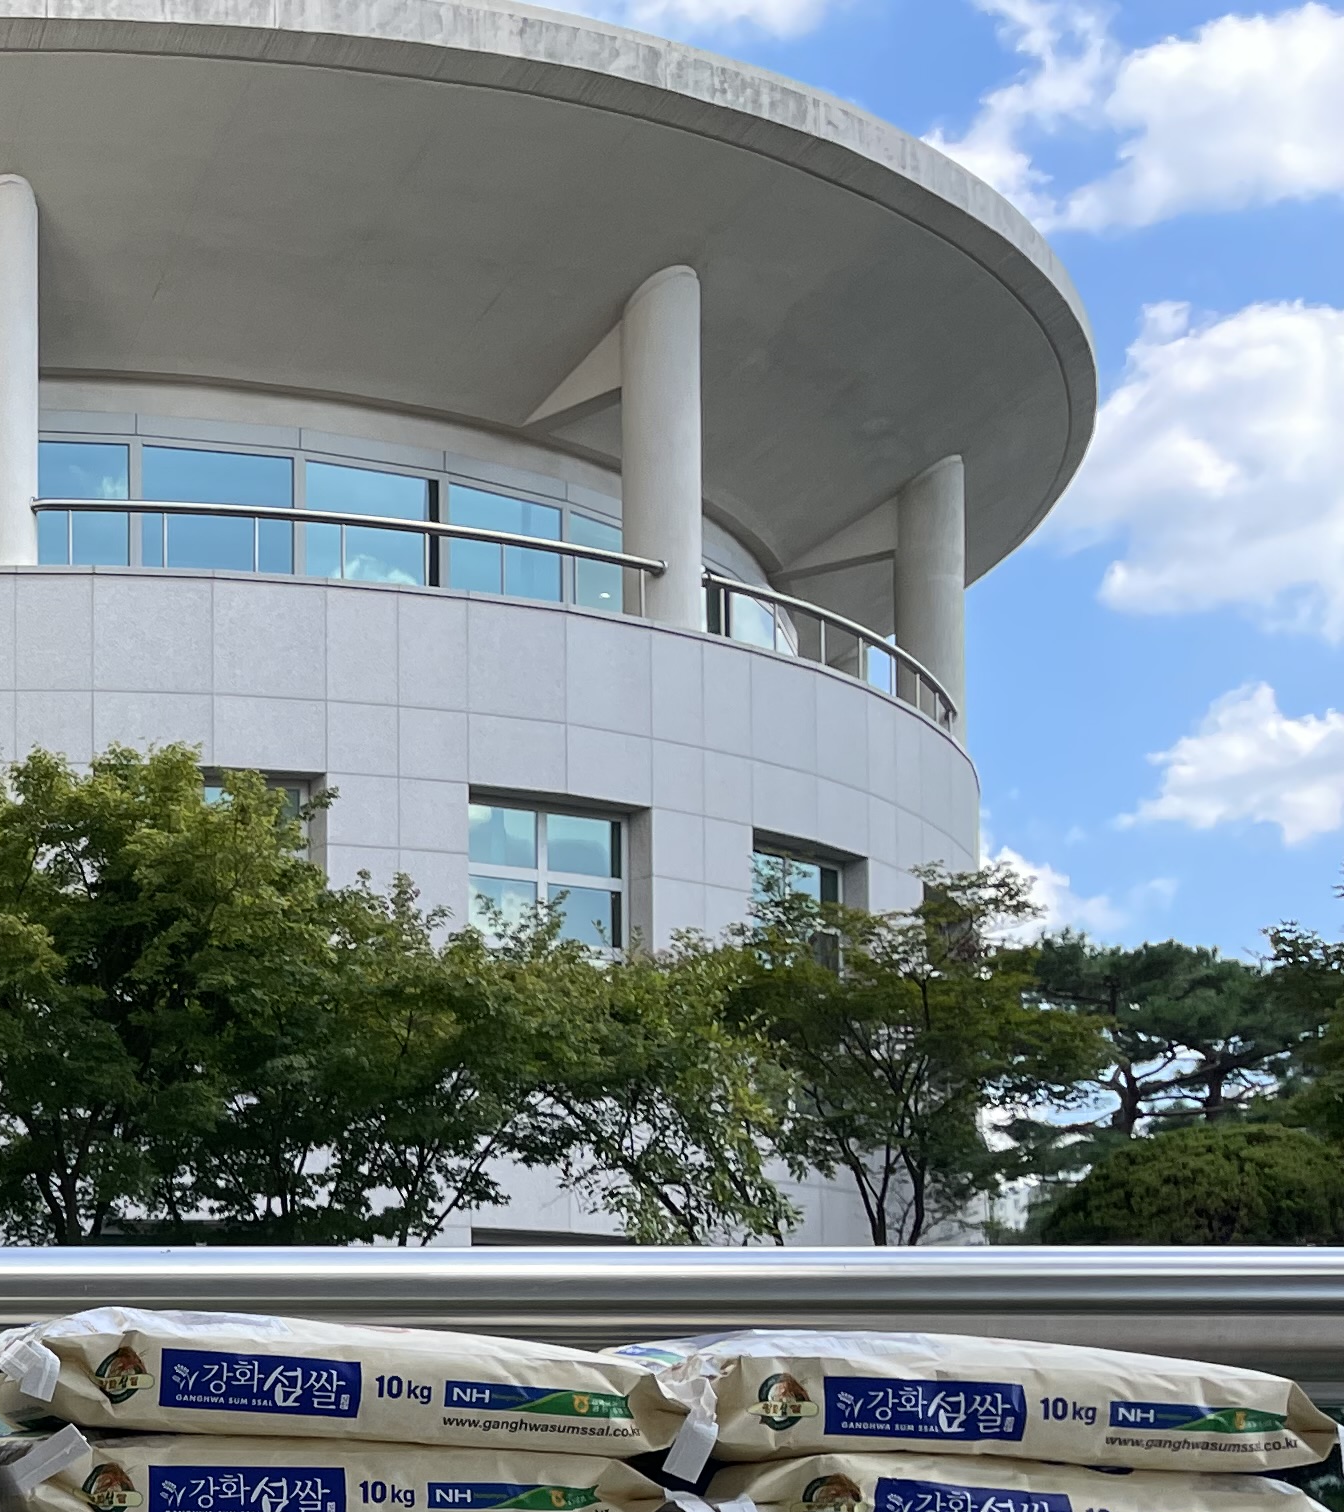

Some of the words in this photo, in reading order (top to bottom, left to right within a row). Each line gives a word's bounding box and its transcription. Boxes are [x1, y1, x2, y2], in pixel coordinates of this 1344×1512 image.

[175, 1394, 224, 1404] GANGHWA
[228, 1397, 248, 1405] SUM
[251, 1398, 272, 1406] SSAL
[201, 1361, 346, 1409] 강화섬쌀
[452, 1387, 490, 1403] NH
[859, 1386, 1010, 1432] 강화섬쌀
[1118, 1407, 1155, 1423] NH
